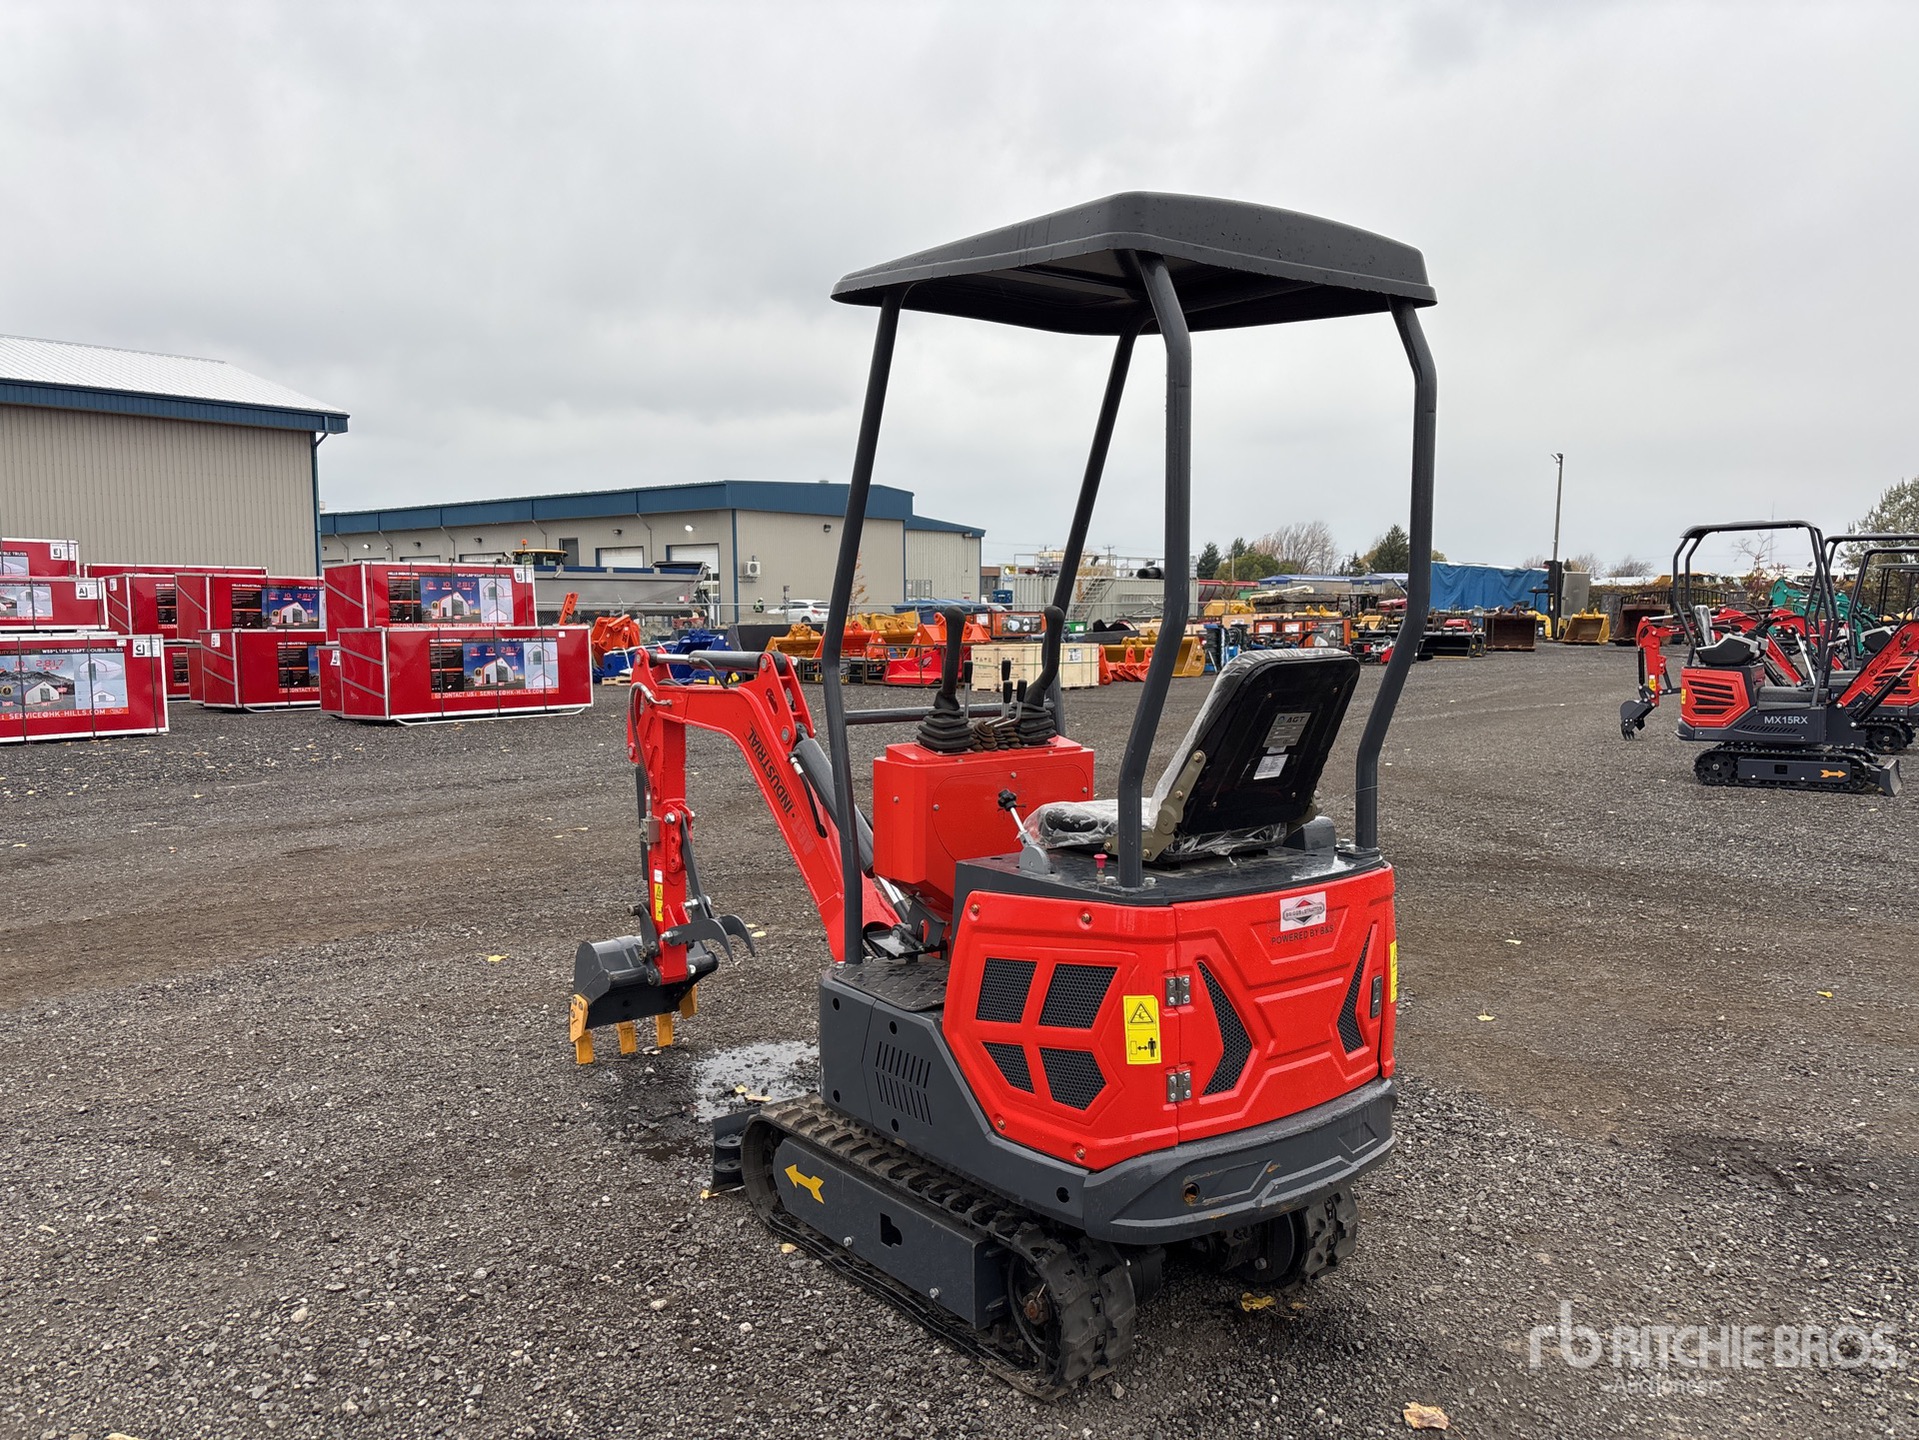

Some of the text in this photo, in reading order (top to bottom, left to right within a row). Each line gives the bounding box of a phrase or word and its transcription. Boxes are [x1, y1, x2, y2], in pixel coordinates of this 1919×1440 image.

[1286, 716, 1306, 724] AGT
[1764, 715, 1808, 725] MX15RX
[748, 728, 794, 814] INDUSTRIAL
[1271, 924, 1335, 945] POWERED BY B&S
